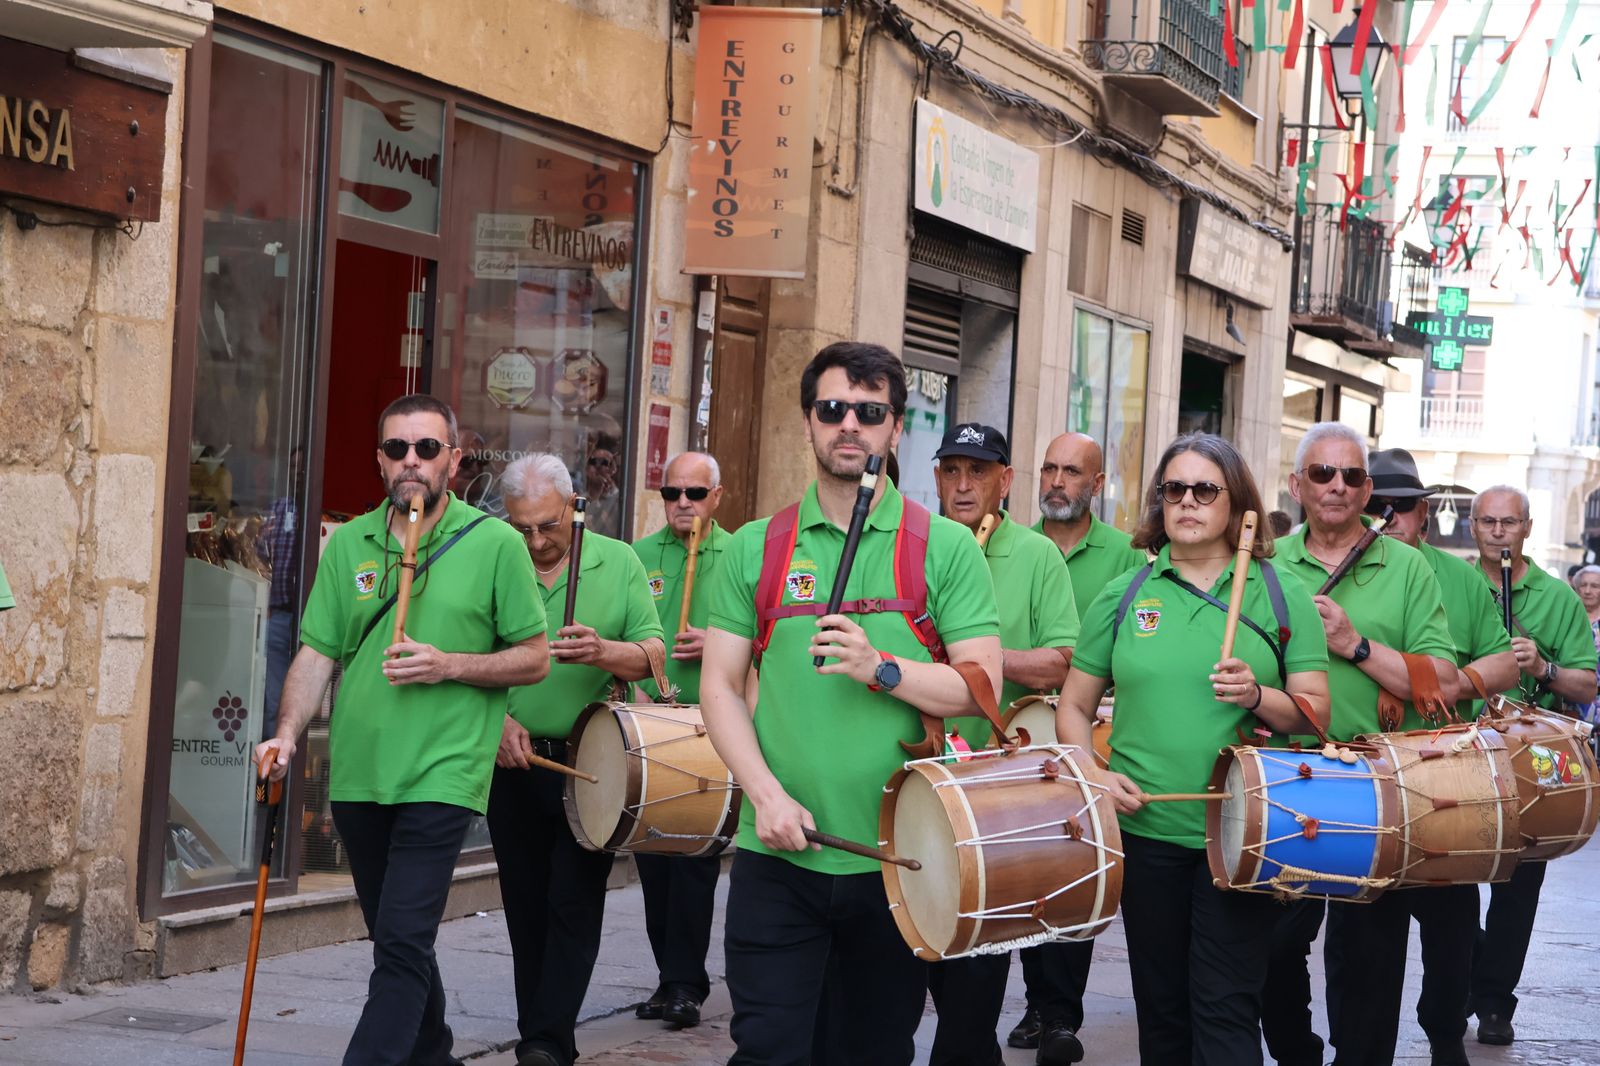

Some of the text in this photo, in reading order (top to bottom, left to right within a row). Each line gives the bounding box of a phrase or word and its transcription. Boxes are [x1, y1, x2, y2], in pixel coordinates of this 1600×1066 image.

[711, 40, 745, 238] ENTREVINOS
[770, 42, 796, 240] GOURMET
[531, 216, 627, 272] ENTREVINOS
[172, 738, 220, 754] ENTRE
